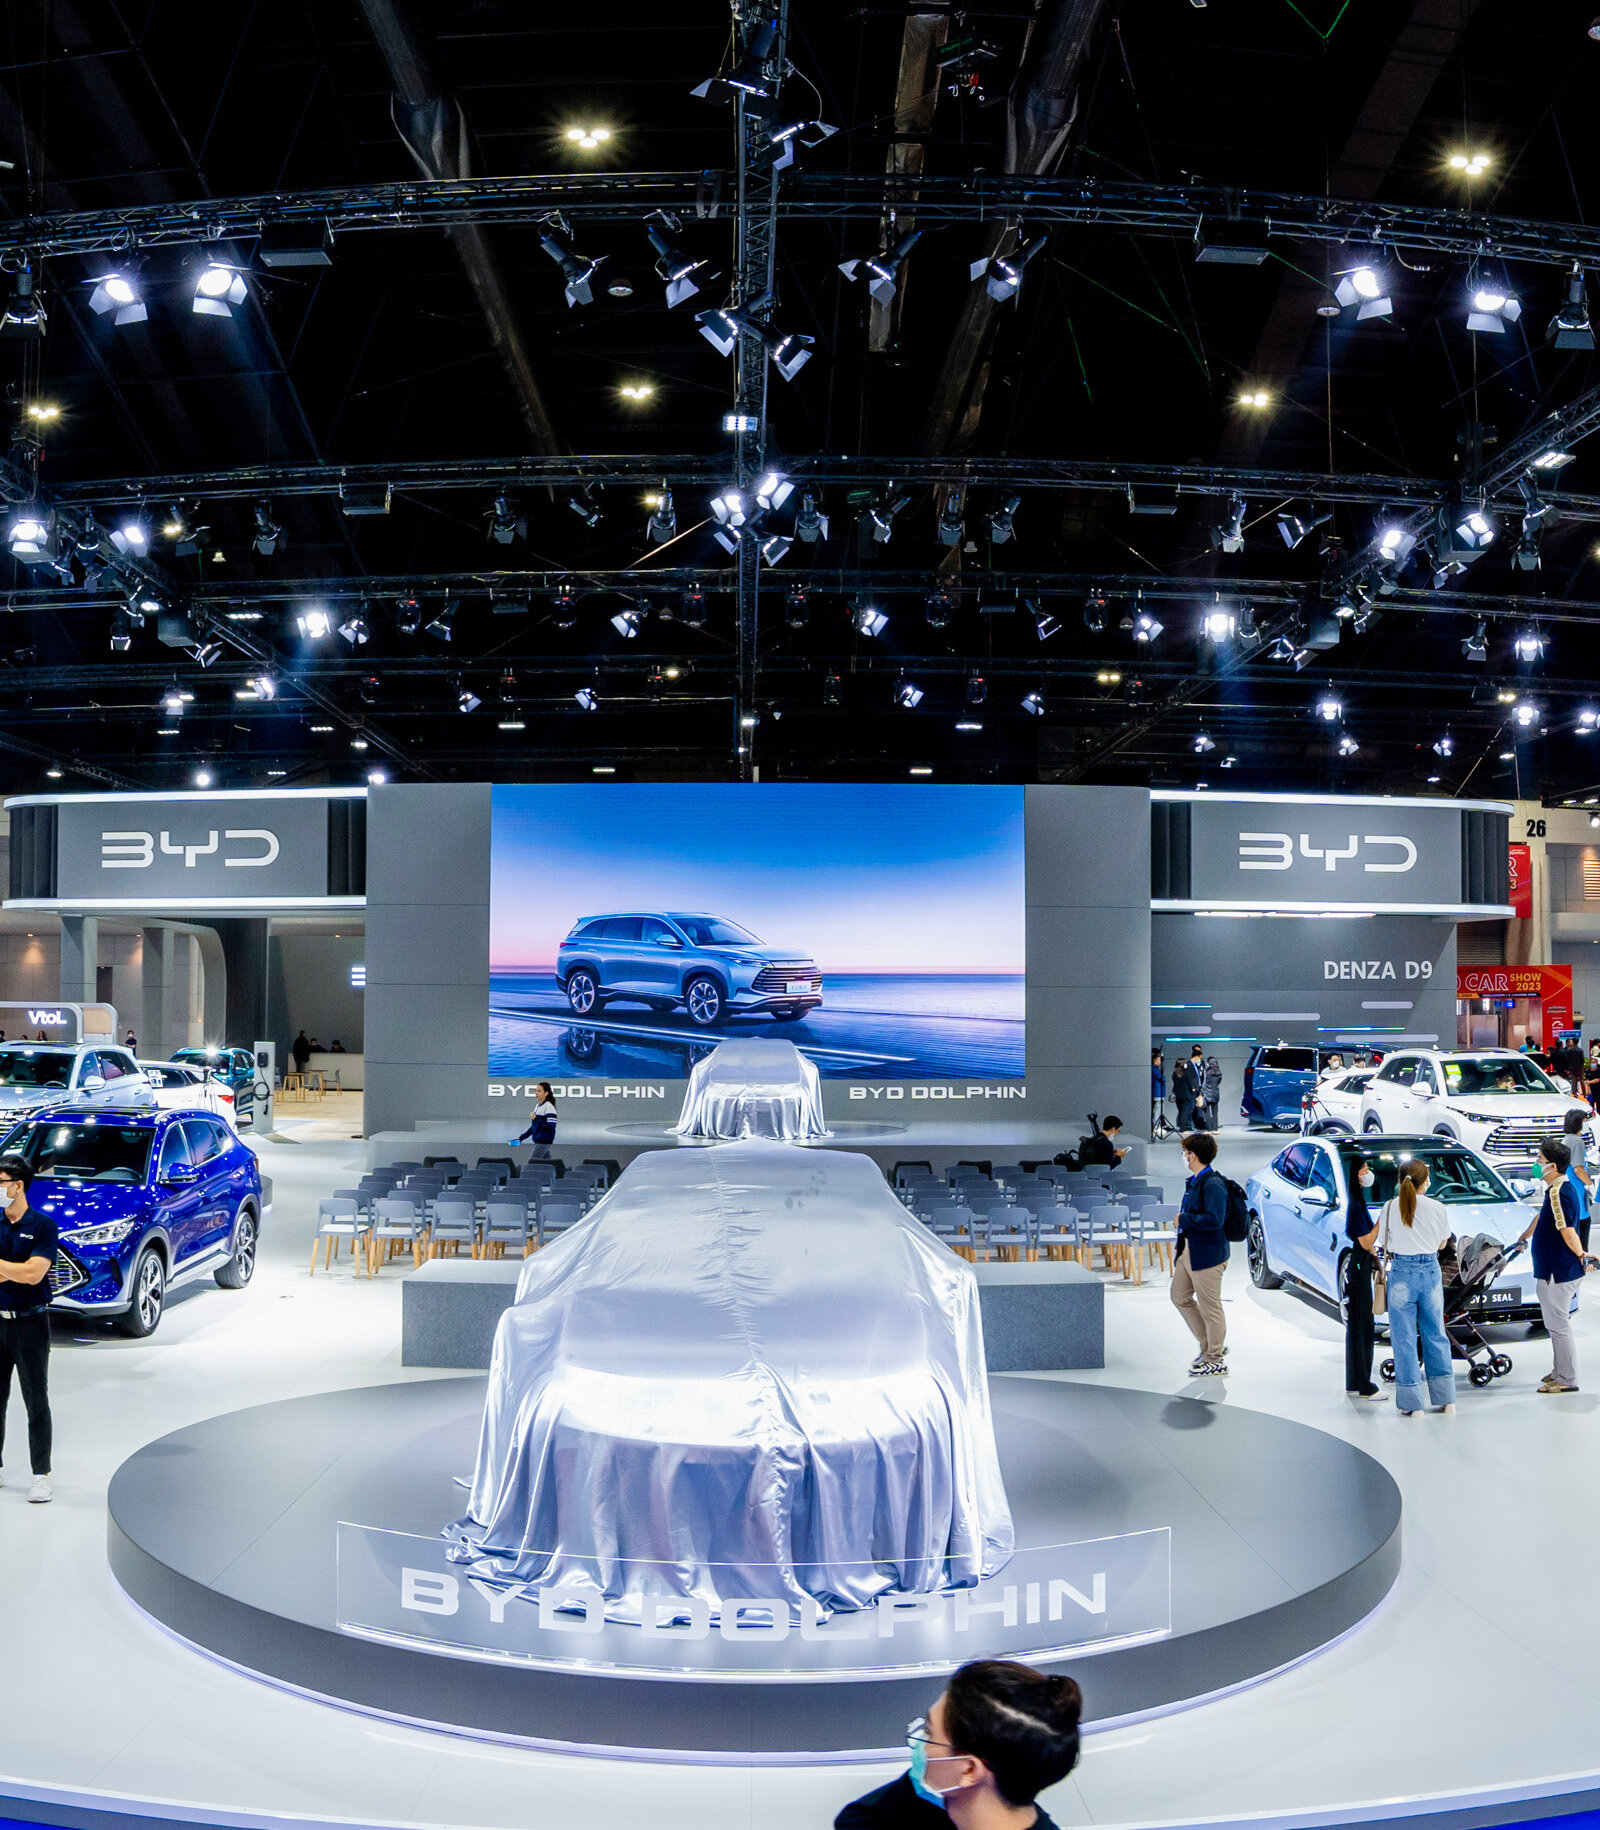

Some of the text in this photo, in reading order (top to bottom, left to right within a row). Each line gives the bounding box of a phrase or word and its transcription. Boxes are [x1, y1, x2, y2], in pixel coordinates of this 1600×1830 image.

[1526, 818, 1547, 838] 26
[102, 829, 280, 868] BYD
[1239, 832, 1418, 873] BYD
[1324, 960, 1433, 980] DENZA D9
[1464, 972, 1542, 991] CAR SHOW
[1516, 981, 1542, 991] 2023
[28, 1010, 67, 1025] VtoL
[849, 1086, 1027, 1099] BYD DOLPHIN
[1492, 1292, 1514, 1303] SEAL
[401, 1567, 1106, 1642] BYD DOLPHIN
